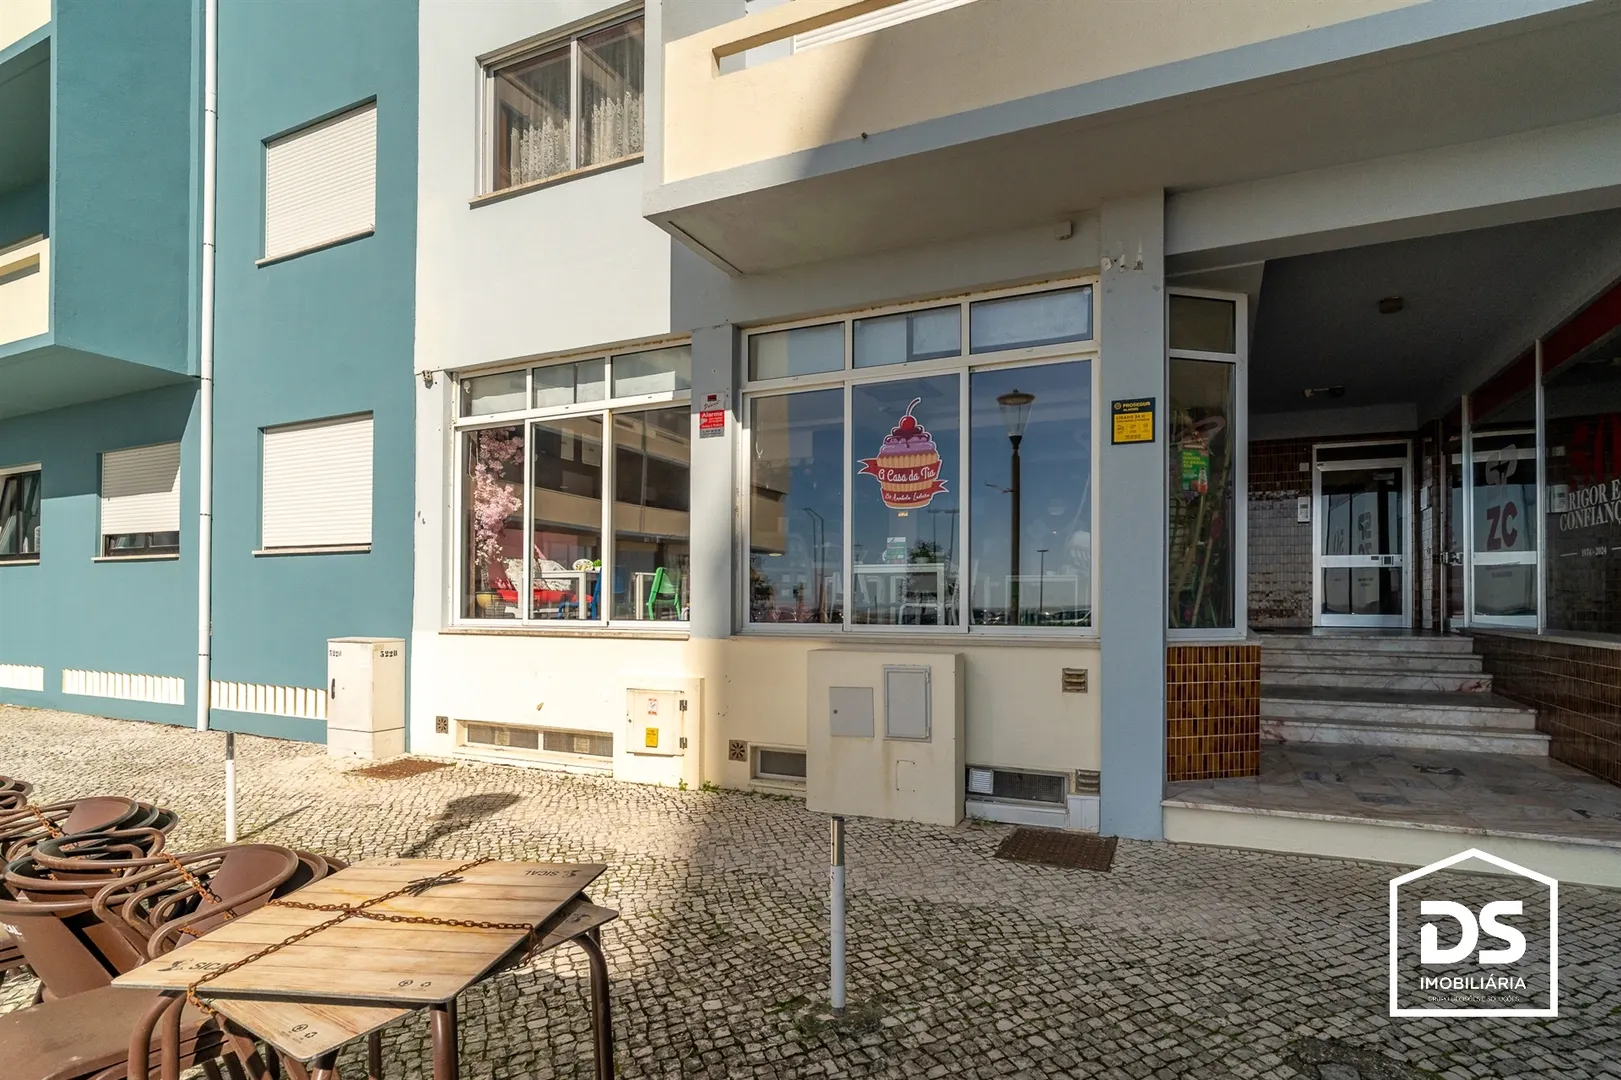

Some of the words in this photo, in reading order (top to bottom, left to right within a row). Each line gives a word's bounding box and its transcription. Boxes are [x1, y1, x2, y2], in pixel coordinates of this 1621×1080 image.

[887, 469, 908, 482] Casa
[908, 469, 920, 482] da
[920, 466, 936, 480] Tia
[1568, 482, 1608, 511] RIGOR
[1611, 478, 1621, 500] E
[1486, 501, 1518, 551] ZC
[525, 869, 560, 877] SICAL
